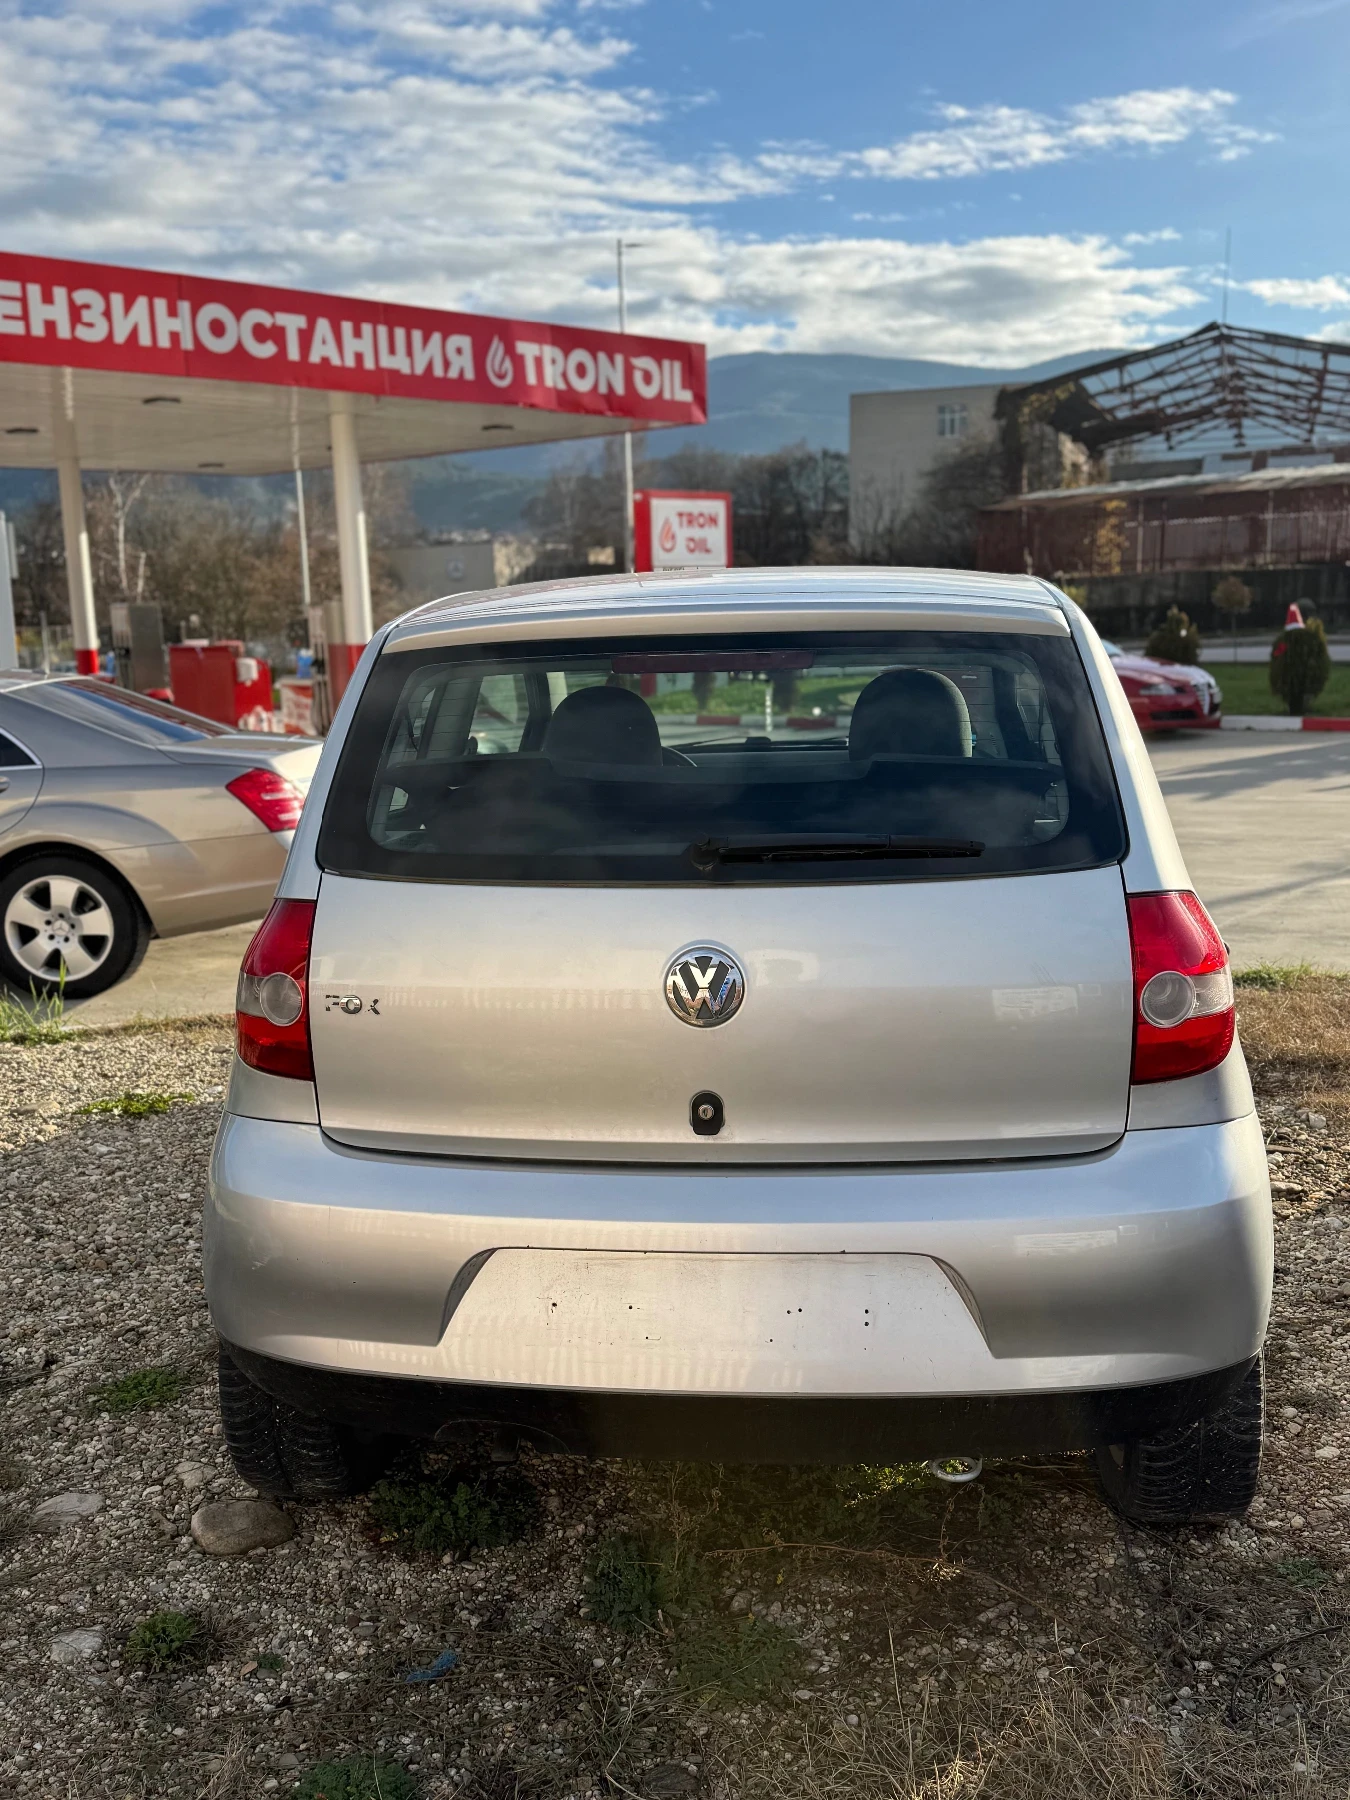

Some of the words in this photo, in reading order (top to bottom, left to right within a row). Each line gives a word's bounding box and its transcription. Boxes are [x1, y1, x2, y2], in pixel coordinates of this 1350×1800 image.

[515, 340, 626, 397] TRON
[629, 355, 694, 403] OIL
[676, 512, 718, 528] TRON
[685, 537, 712, 554] OIL
[325, 994, 380, 1015] FOX
